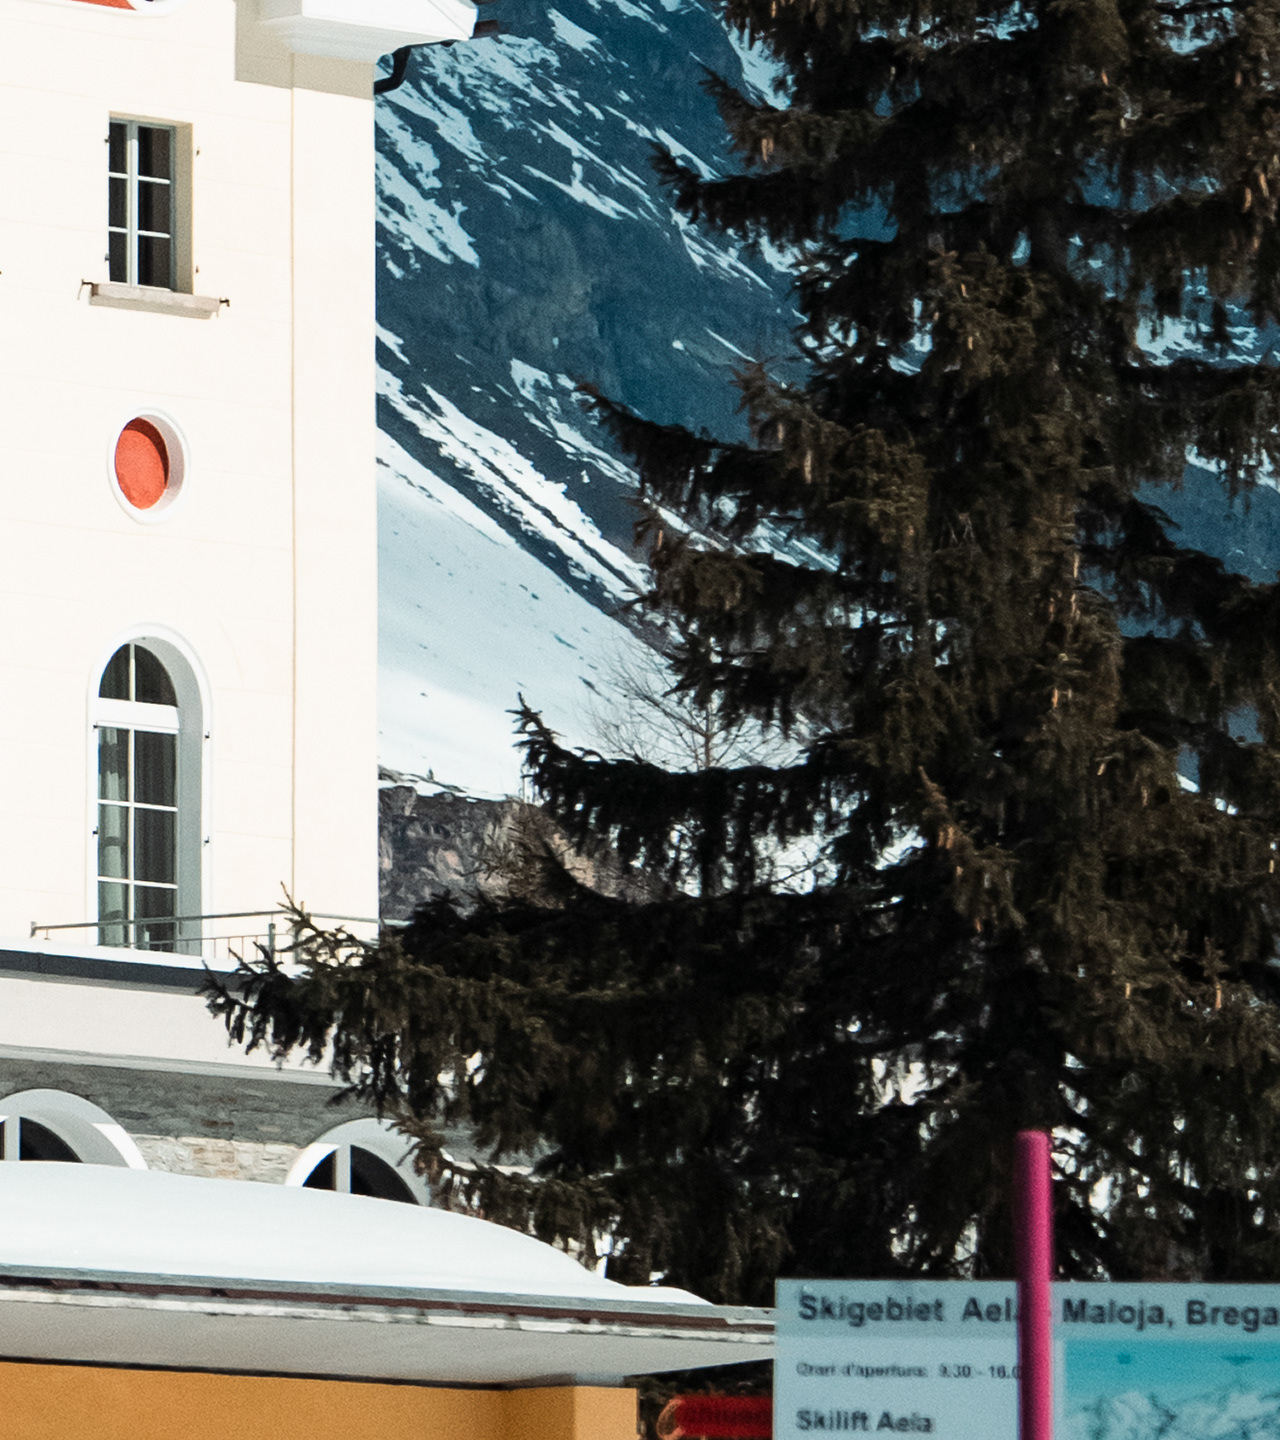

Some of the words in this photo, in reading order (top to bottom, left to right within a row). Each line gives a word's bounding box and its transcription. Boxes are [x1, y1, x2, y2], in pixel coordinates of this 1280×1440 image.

[798, 1294, 943, 1328] Skigebiet
[962, 1296, 1020, 1323] Ael
[1062, 1298, 1174, 1332] Maloja,
[796, 1409, 869, 1432] Skilift
